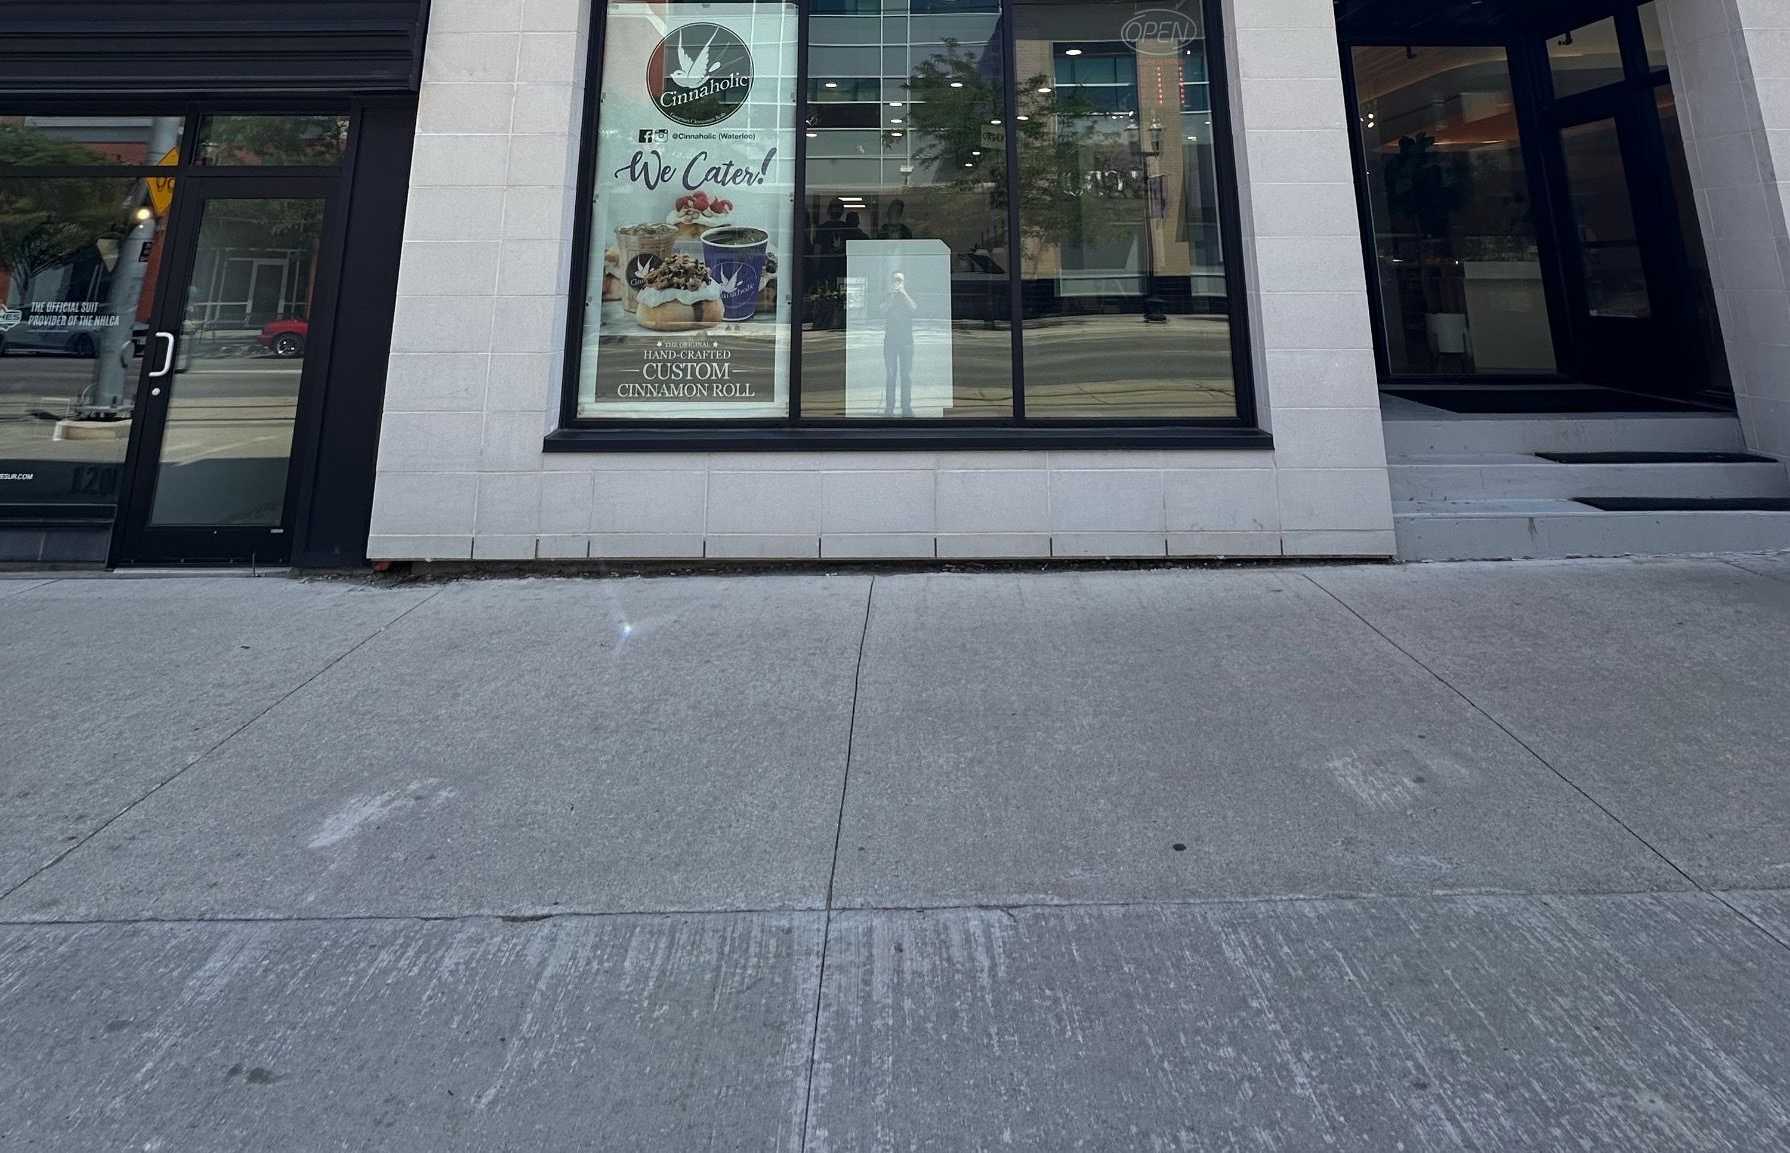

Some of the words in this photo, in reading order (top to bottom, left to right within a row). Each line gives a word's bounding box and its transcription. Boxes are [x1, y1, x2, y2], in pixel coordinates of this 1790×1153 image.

[1125, 21, 1189, 43] OPEN
[660, 72, 751, 107] Cinnaholic
[672, 132, 716, 140] @Cinnaholic
[614, 149, 677, 191] We
[682, 147, 777, 191] Cater!
[31, 302, 45, 312] THE
[46, 302, 79, 312] OFFICIAL
[81, 302, 99, 312] SUIT
[28, 315, 66, 326] PROVIDER
[67, 315, 77, 326] OF
[79, 315, 94, 326] THE
[94, 315, 119, 326] NHLCA
[643, 350, 731, 360] HAND-CRAFTED
[642, 362, 730, 380] CUSTOM
[617, 383, 709, 397] CINNAMON
[710, 383, 755, 397] ROLL
